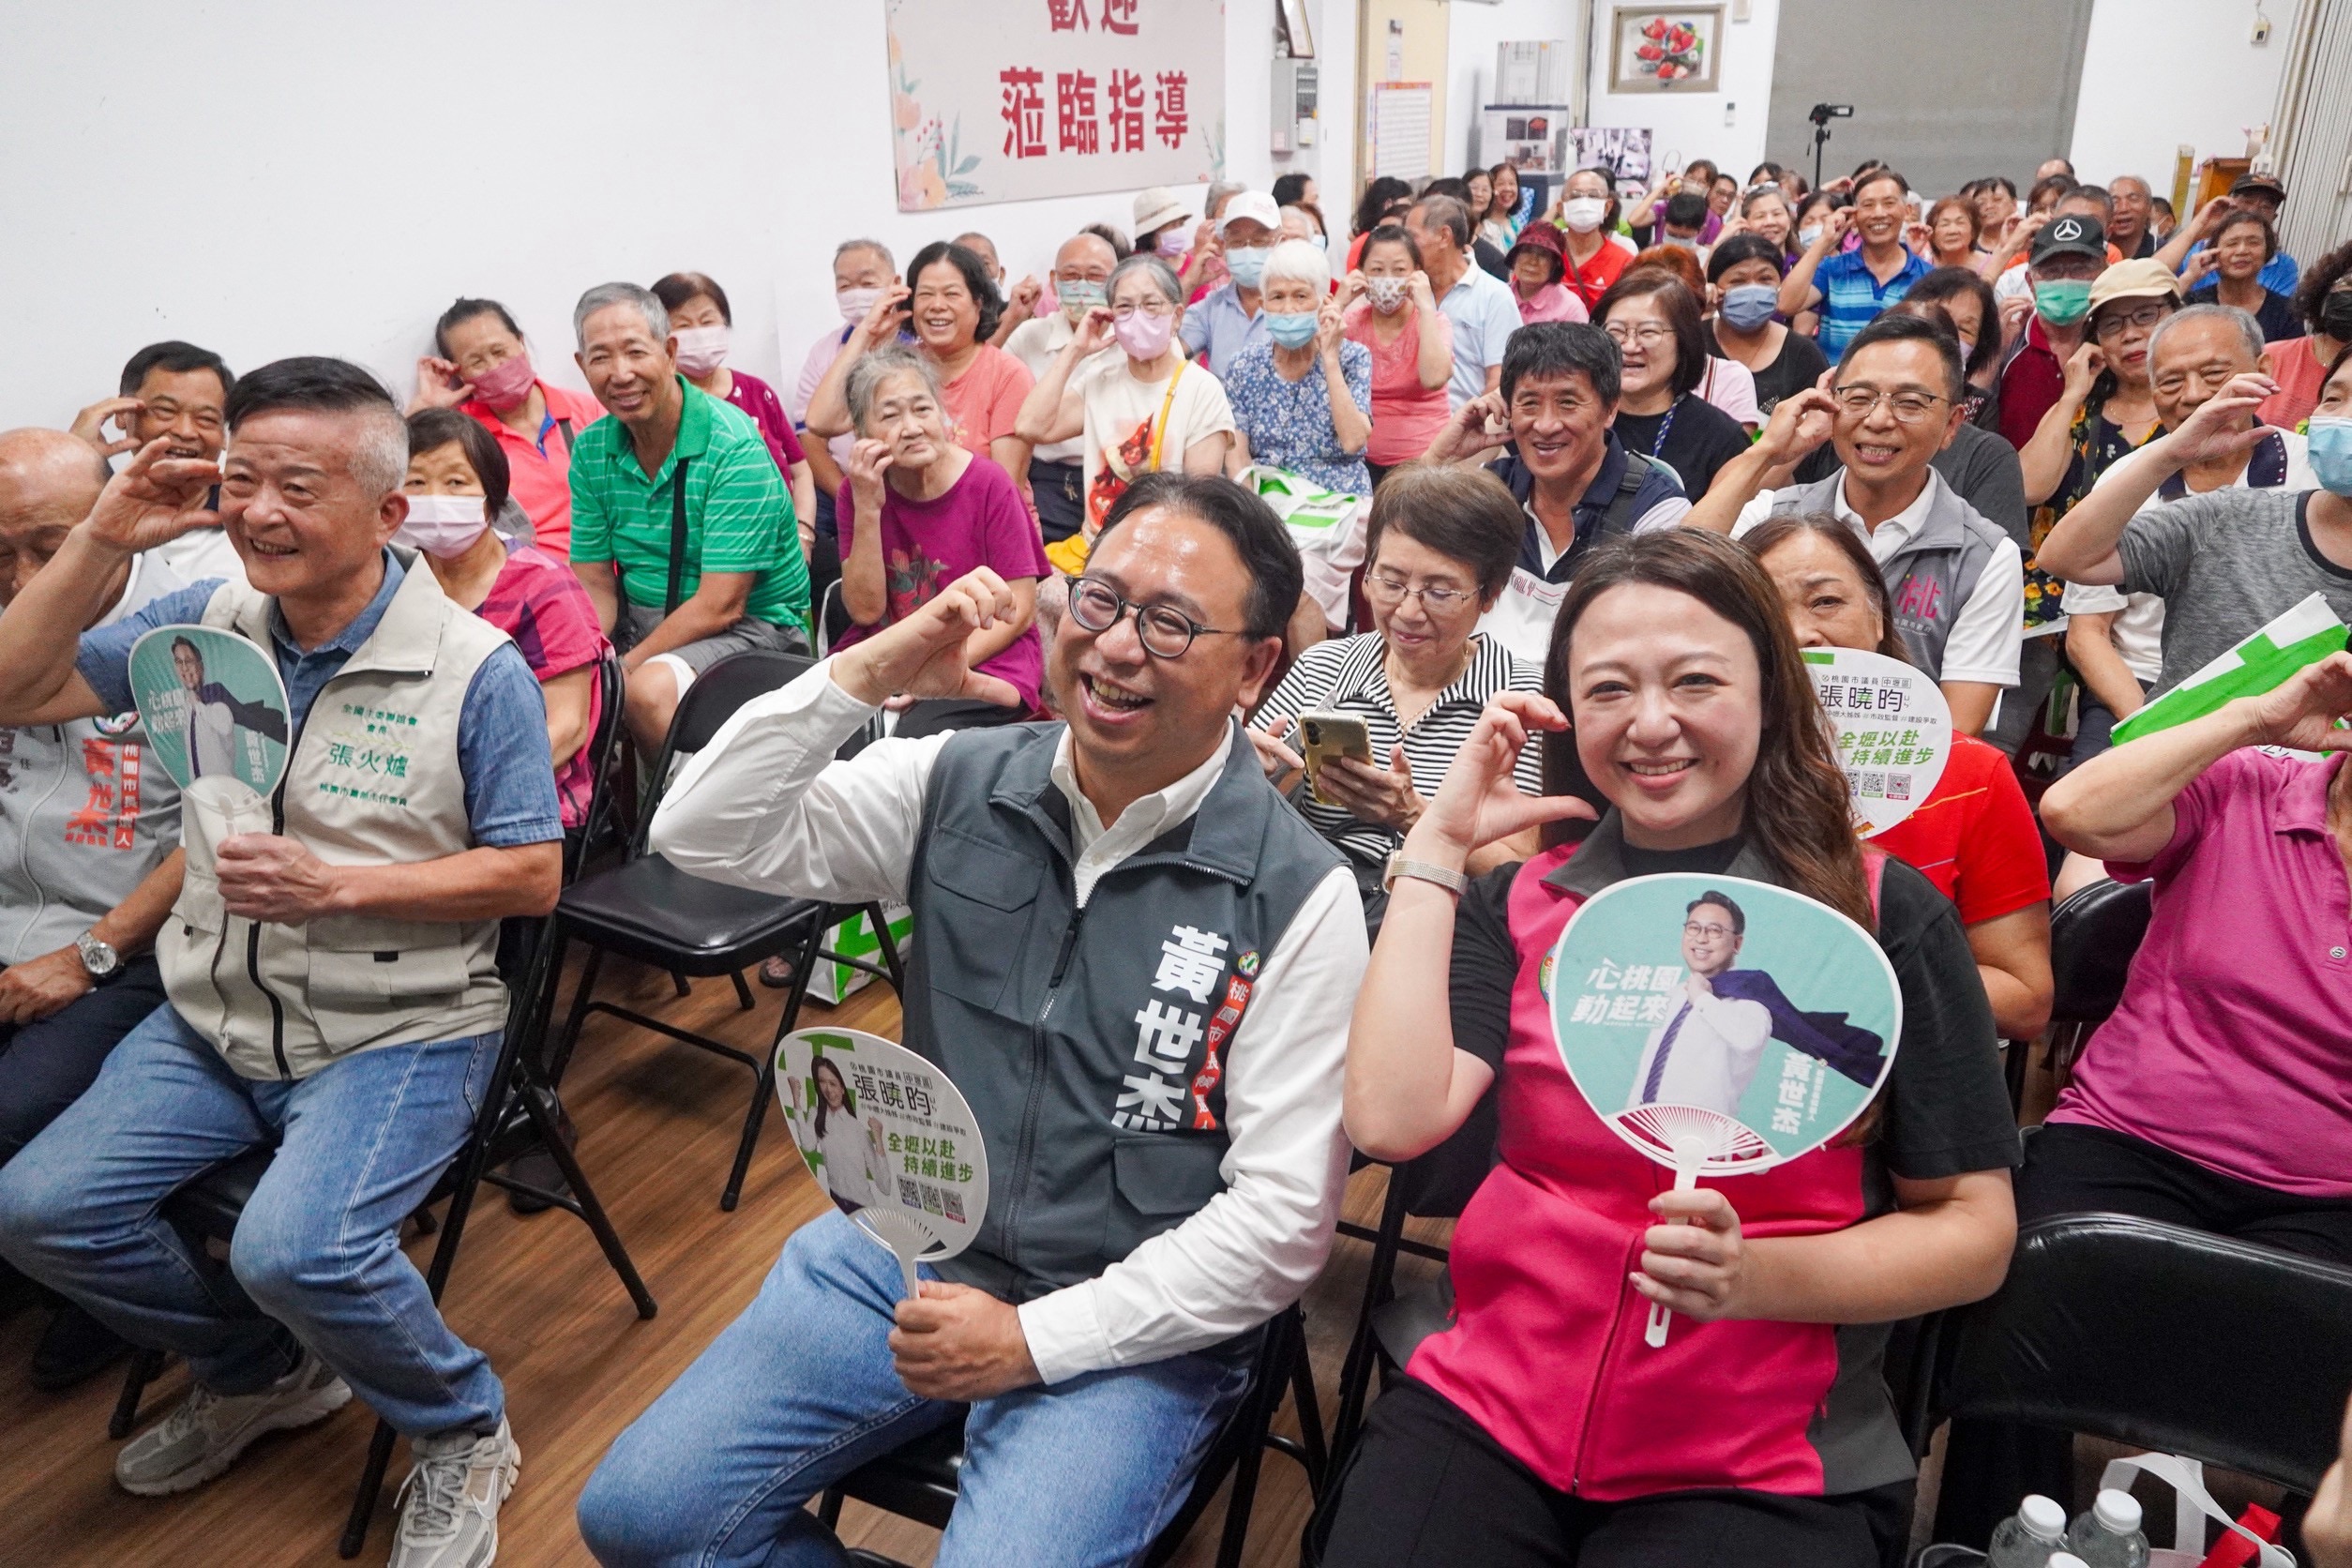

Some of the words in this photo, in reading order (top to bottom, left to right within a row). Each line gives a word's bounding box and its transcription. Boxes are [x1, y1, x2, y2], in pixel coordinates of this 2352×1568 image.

[1000, 67, 1188, 159] 蒞臨指導
[1832, 675, 1878, 686] 桃園市議員
[1883, 678, 1909, 687] 中壢區
[1820, 685, 1903, 713] 張曉昀
[1838, 730, 1920, 748] 全壢以赴
[328, 742, 409, 778] 張火爐
[1850, 746, 1934, 765] 持續進步
[1586, 957, 1683, 991] 心桃園
[1570, 993, 1669, 1025] 動起來
[1111, 925, 1229, 1129] 黃世杰
[852, 1073, 932, 1116] 張曉昀
[1772, 1052, 1814, 1136] 黃世杰
[887, 1132, 956, 1159] 全壢以赴
[904, 1153, 973, 1183] 持續進步
